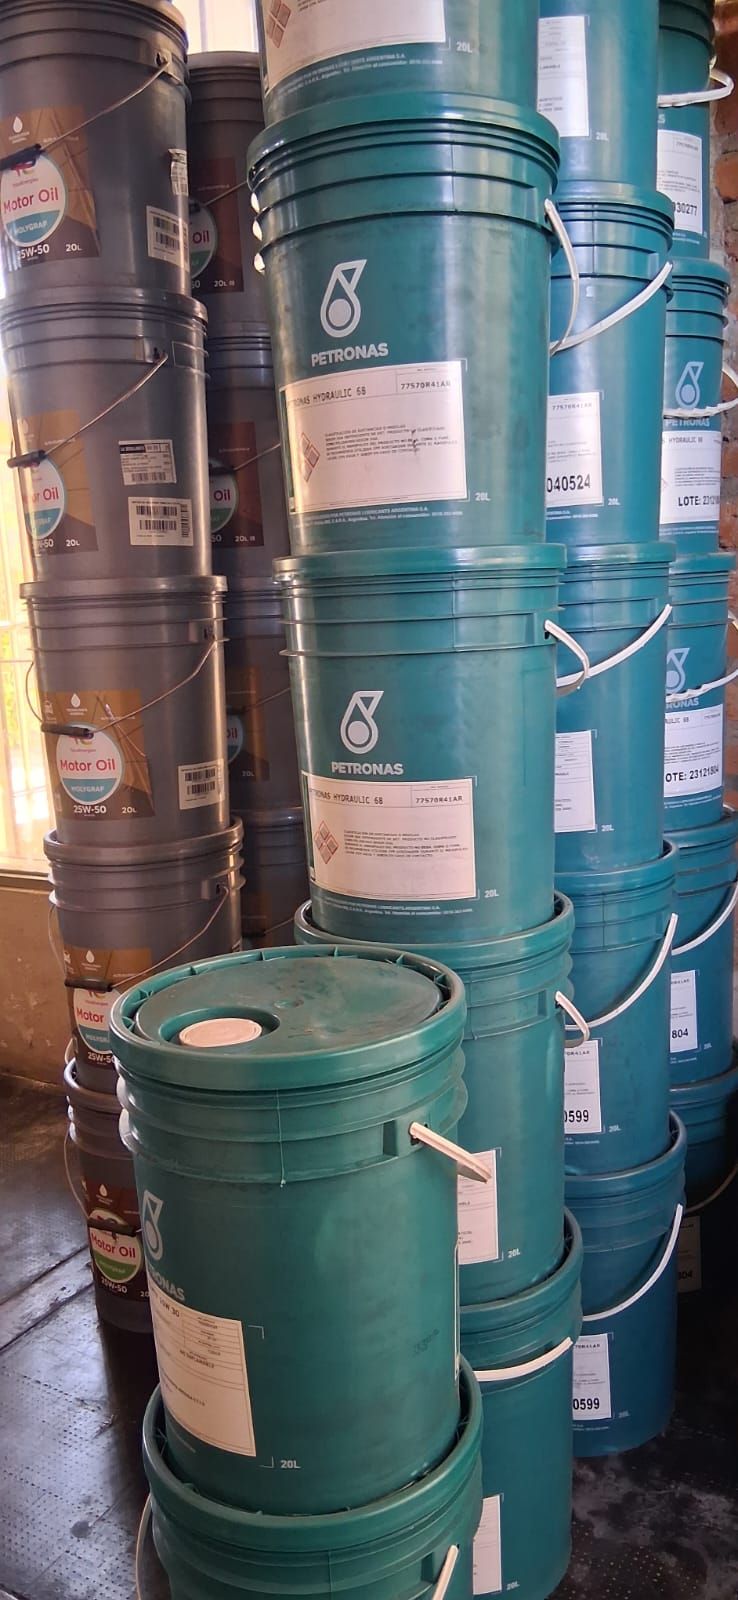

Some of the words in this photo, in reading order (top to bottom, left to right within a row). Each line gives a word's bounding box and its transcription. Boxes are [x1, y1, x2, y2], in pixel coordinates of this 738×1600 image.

[3, 194, 34, 214] Motor
[38, 187, 59, 202] Oil
[192, 230, 210, 244] Oil
[311, 342, 389, 367] PETRONAS
[313, 387, 352, 402] HYDRAULIC
[546, 473, 591, 493] 040524
[42, 487, 59, 501] Oil
[213, 489, 231, 502] Oil
[678, 495, 701, 507] LOTE:
[60, 759, 92, 772] Motor
[96, 758, 116, 772] Oil
[331, 761, 404, 776] PETRONAS
[333, 793, 370, 805] HYDRAULIC
[73, 805, 107, 815] 25W-50
[76, 1007, 105, 1024] Motor
[671, 1028, 689, 1039] 804
[91, 1232, 116, 1254] Motor
[119, 1246, 136, 1258] Oil
[573, 1397, 600, 1411] 0599
[280, 1459, 301, 1469] 20L
